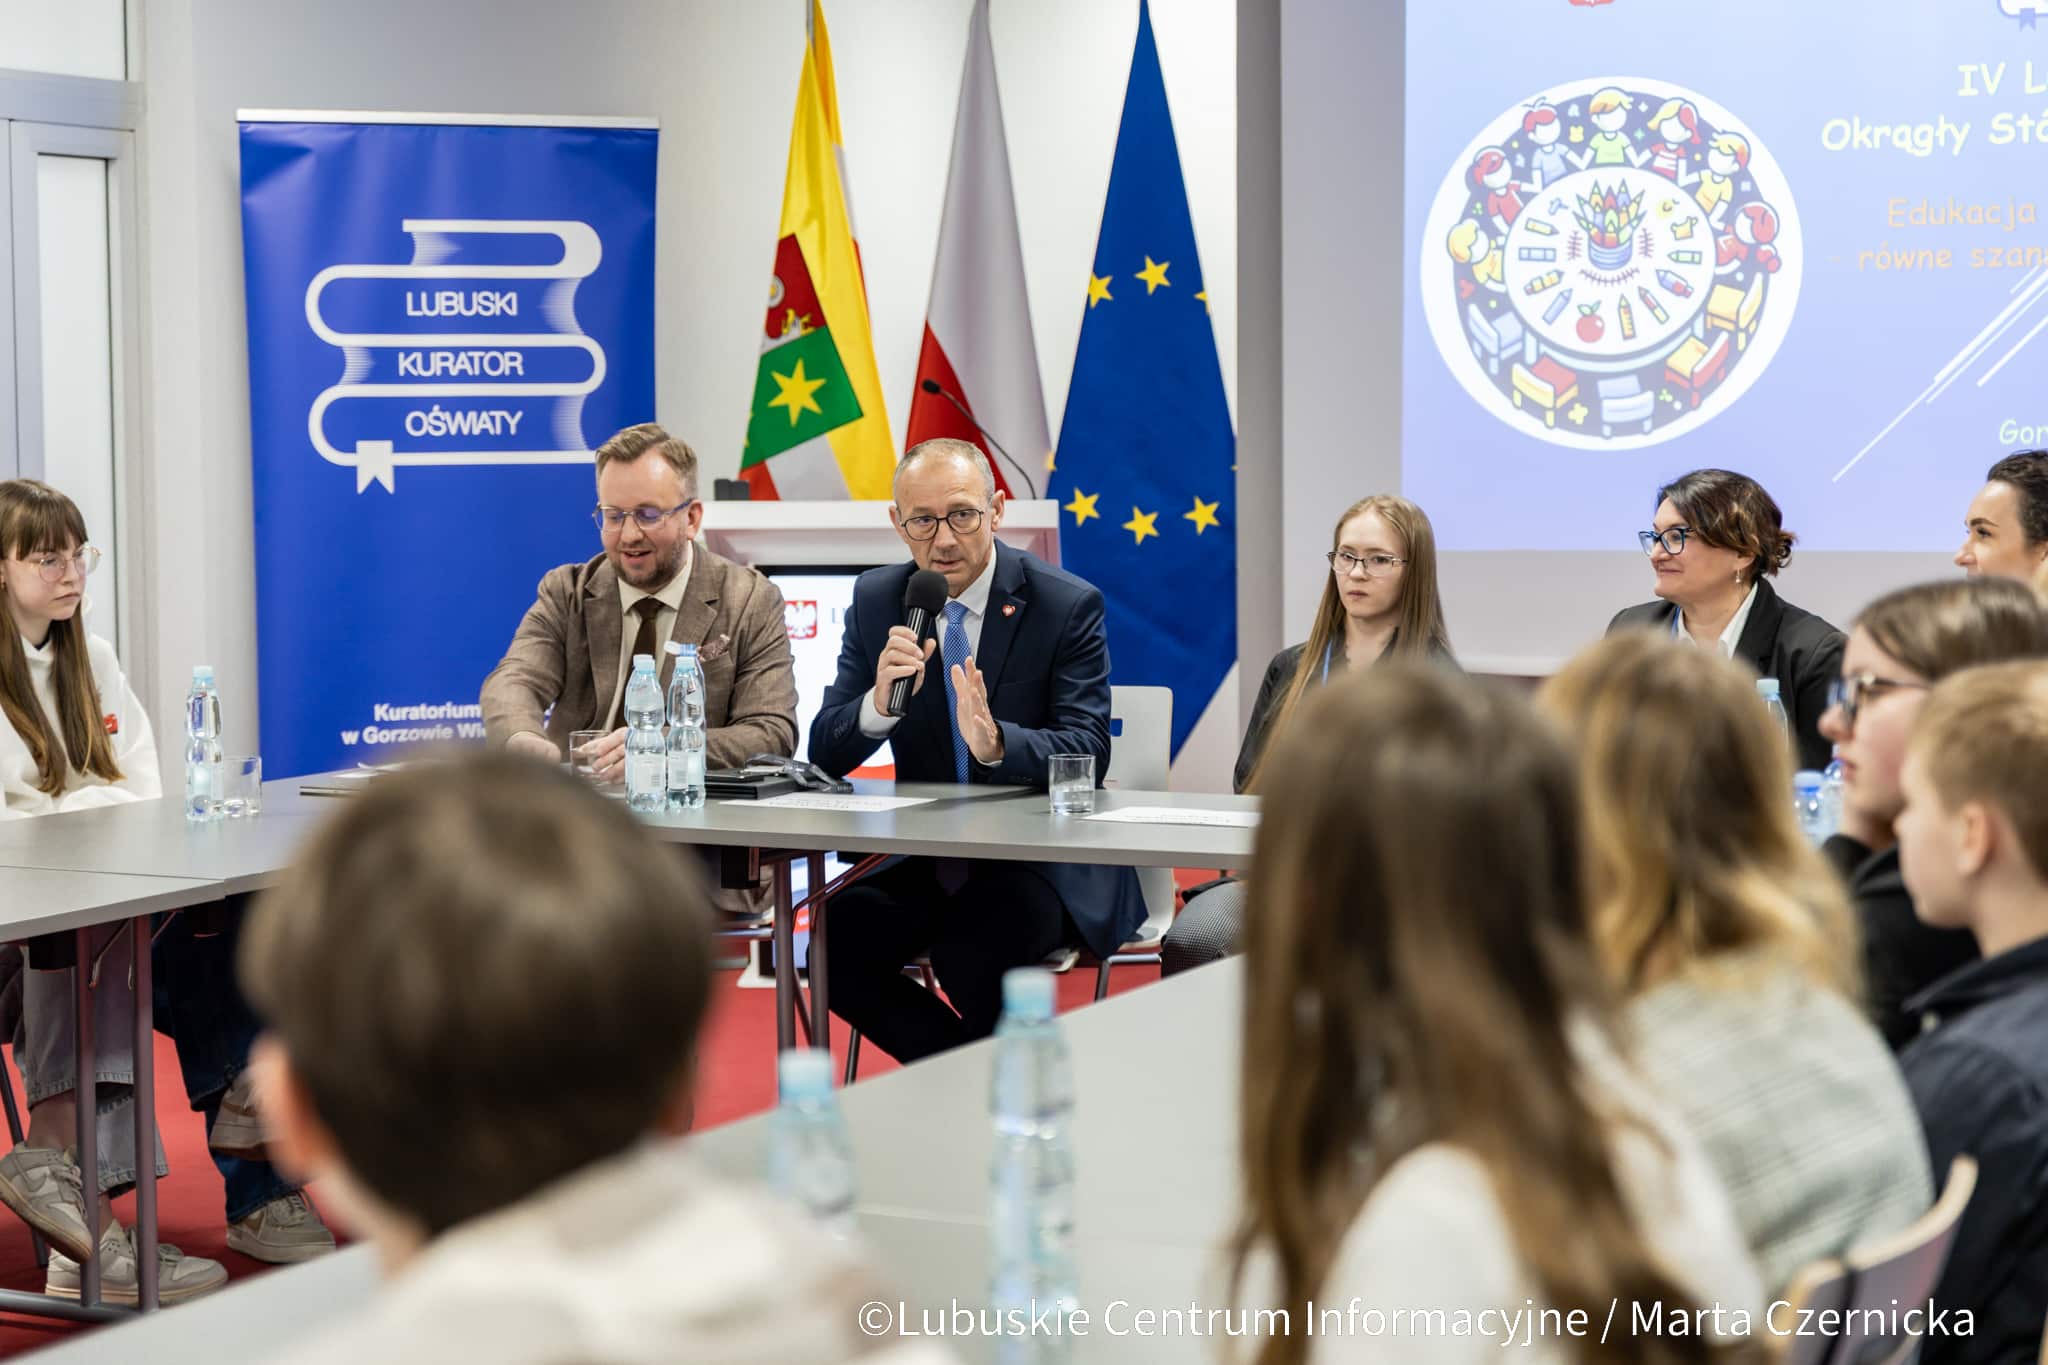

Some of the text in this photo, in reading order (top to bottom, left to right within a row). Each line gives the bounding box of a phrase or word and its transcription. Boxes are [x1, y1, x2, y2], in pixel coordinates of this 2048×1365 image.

[1957, 59, 2048, 97] IV L
[1821, 114, 1971, 157] Okrągły
[1887, 196, 2037, 232] Edukacja
[1858, 241, 1953, 273] równe
[1970, 246, 2048, 270] szan
[405, 290, 519, 317] LUBUSKI
[398, 351, 525, 377] KURATOR
[405, 404, 524, 436] OŚWIATY
[373, 701, 482, 722] Kuratorium
[341, 730, 359, 746] w
[362, 723, 454, 745] Gorzowie
